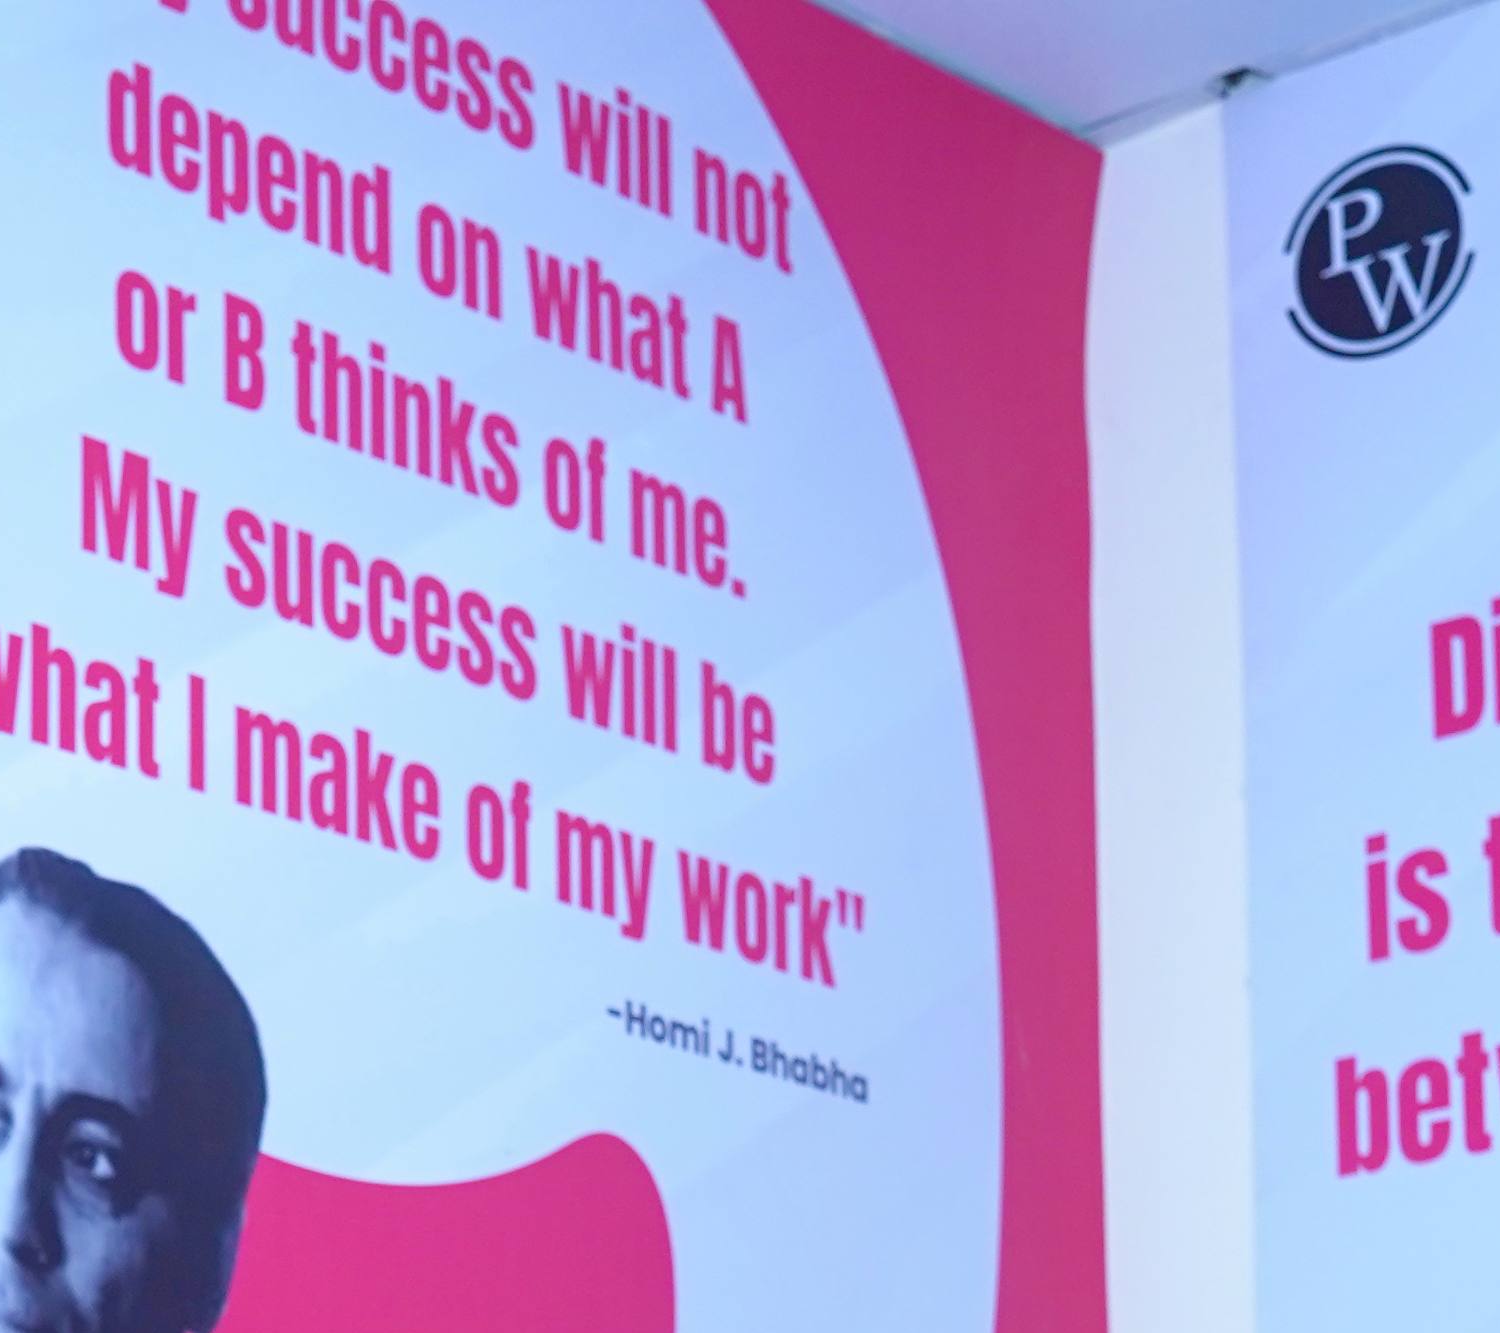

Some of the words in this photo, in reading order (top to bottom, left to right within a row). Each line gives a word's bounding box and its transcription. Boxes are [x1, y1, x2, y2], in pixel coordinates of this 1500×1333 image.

[109, 64, 391, 273] depend
[418, 204, 501, 319] on
[528, 247, 689, 398] what
[713, 317, 746, 421] A
[560, 84, 671, 216] will
[695, 150, 791, 272] not
[116, 271, 196, 384] or
[225, 293, 265, 410] B
[292, 321, 518, 507] thinks
[545, 438, 605, 542] of
[631, 470, 747, 597] me.
[82, 436, 197, 597] My
[225, 508, 536, 700] success
[562, 624, 676, 752] will
[702, 662, 774, 784] be
[190, 675, 205, 791] I
[236, 707, 439, 860] make
[467, 781, 530, 890] of
[557, 811, 654, 940] my
[1367, 834, 1450, 961] is
[718, 1030, 743, 1066] J.
[750, 1037, 869, 1103] Bhabha
